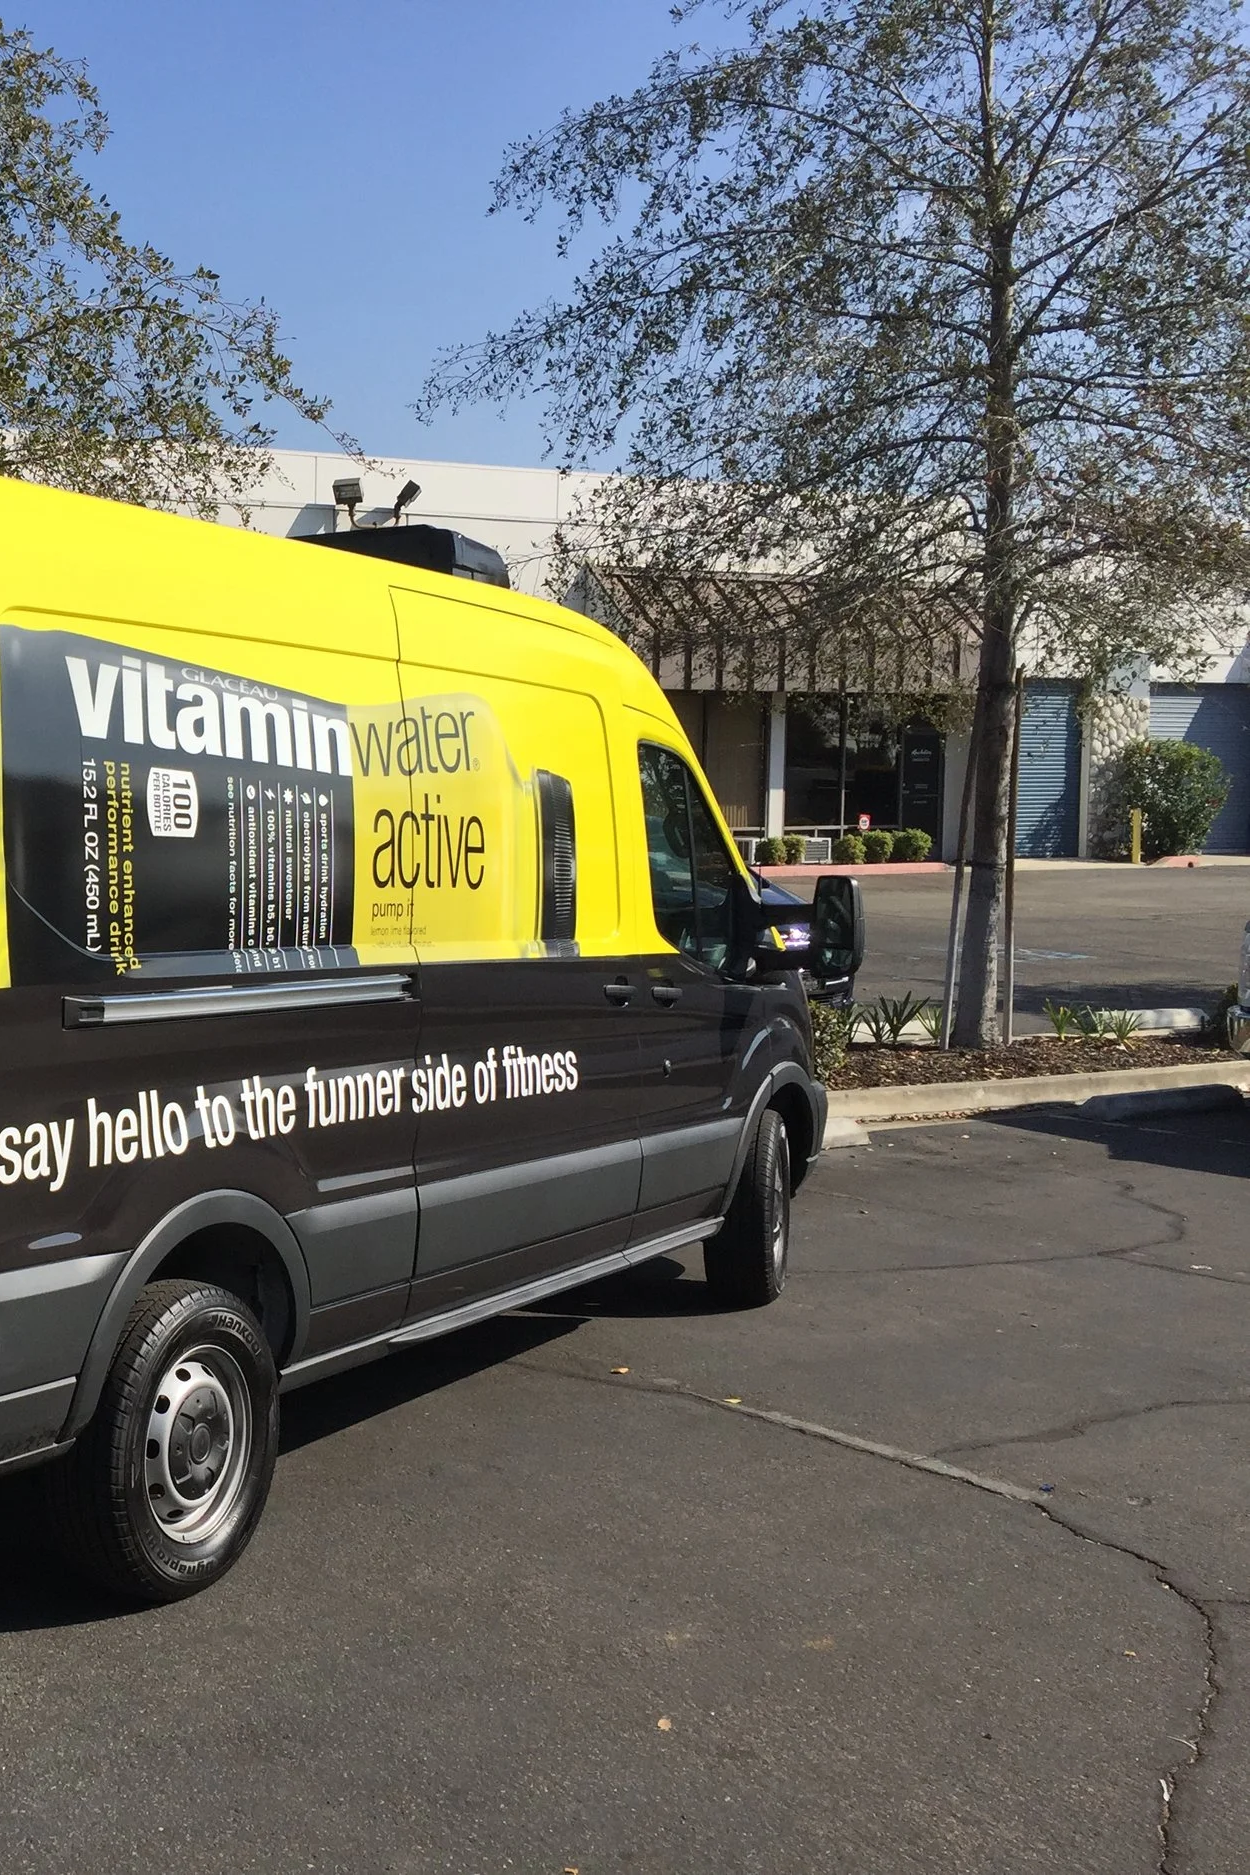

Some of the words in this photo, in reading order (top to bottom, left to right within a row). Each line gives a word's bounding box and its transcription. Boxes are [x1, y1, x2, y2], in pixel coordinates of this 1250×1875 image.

[82, 758, 97, 799] 15.2
[152, 772, 161, 790] PER
[226, 776, 234, 799] see
[83, 803, 99, 828] FL
[120, 762, 134, 853] nutrient
[153, 792, 162, 833] BOTTLE
[161, 773, 172, 832] CALORIES
[172, 778, 192, 830] 100
[84, 832, 100, 860] OZ
[103, 760, 120, 914] performance
[227, 802, 237, 857] nutrition
[247, 806, 257, 879] antioxidant
[266, 810, 276, 843] 100%
[285, 809, 294, 853] natural
[302, 811, 311, 882] electrolytes
[319, 812, 329, 850] sports
[372, 793, 486, 891] active
[84, 863, 101, 910] (450
[228, 860, 238, 894] facts
[267, 846, 276, 901] vitamins
[285, 856, 294, 921] sweetener
[320, 853, 329, 883] drink
[122, 860, 142, 970] enhanced
[228, 897, 237, 916] for
[247, 882, 257, 937] vitamins
[302, 884, 311, 913] from
[319, 887, 329, 939] hydration
[371, 902, 404, 922] pump
[85, 914, 102, 953] mL)
[109, 921, 127, 976] drink
[228, 918, 237, 950] more
[403, 925, 427, 936] flaored
[86, 1089, 190, 1168] hello
[196, 1085, 237, 1149] to
[240, 1075, 296, 1137] the
[303, 1066, 406, 1130] funner
[411, 1053, 467, 1114] side
[473, 1046, 499, 1103] of
[502, 1044, 579, 1099] fitness
